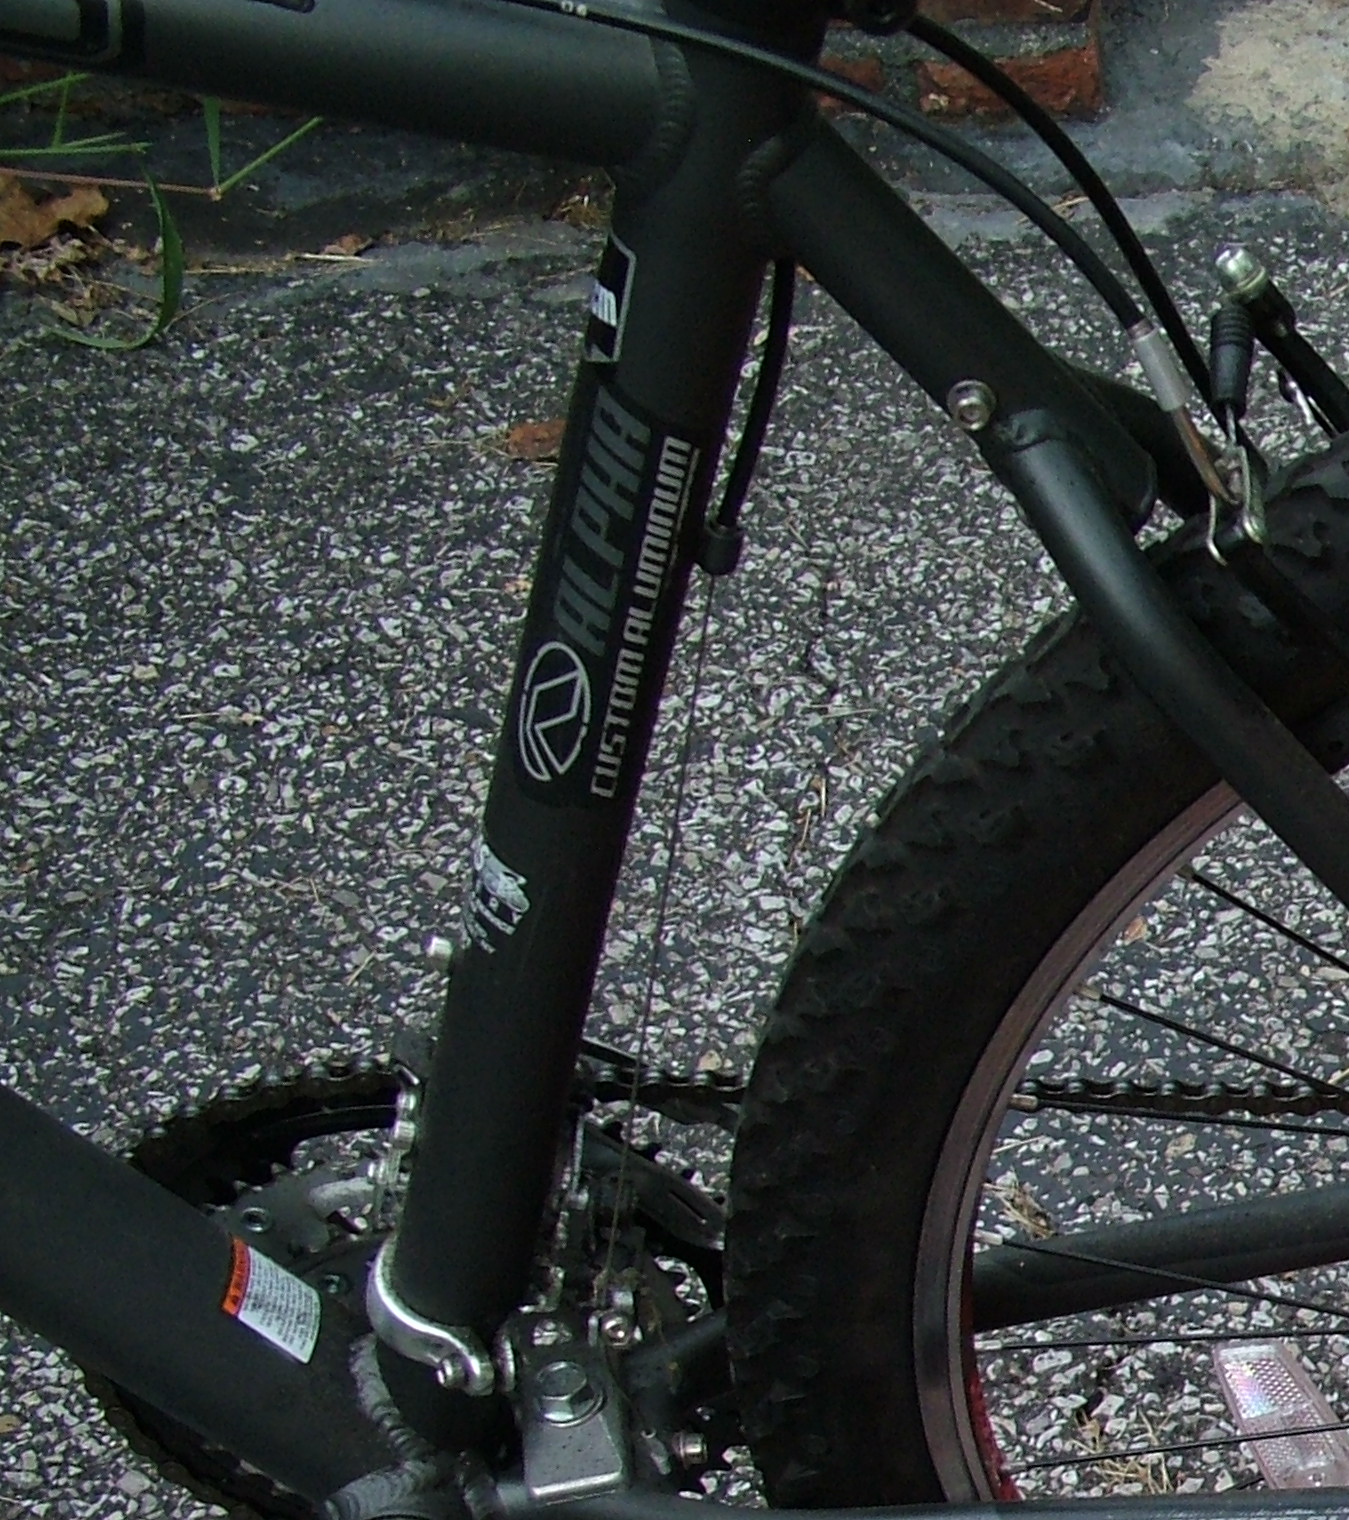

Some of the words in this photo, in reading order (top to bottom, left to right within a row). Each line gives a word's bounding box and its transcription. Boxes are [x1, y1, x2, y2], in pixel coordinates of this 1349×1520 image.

[552, 386, 652, 656] ALPHA
[590, 645, 651, 798] CUSTOM
[621, 435, 692, 646] ALUMINUM
